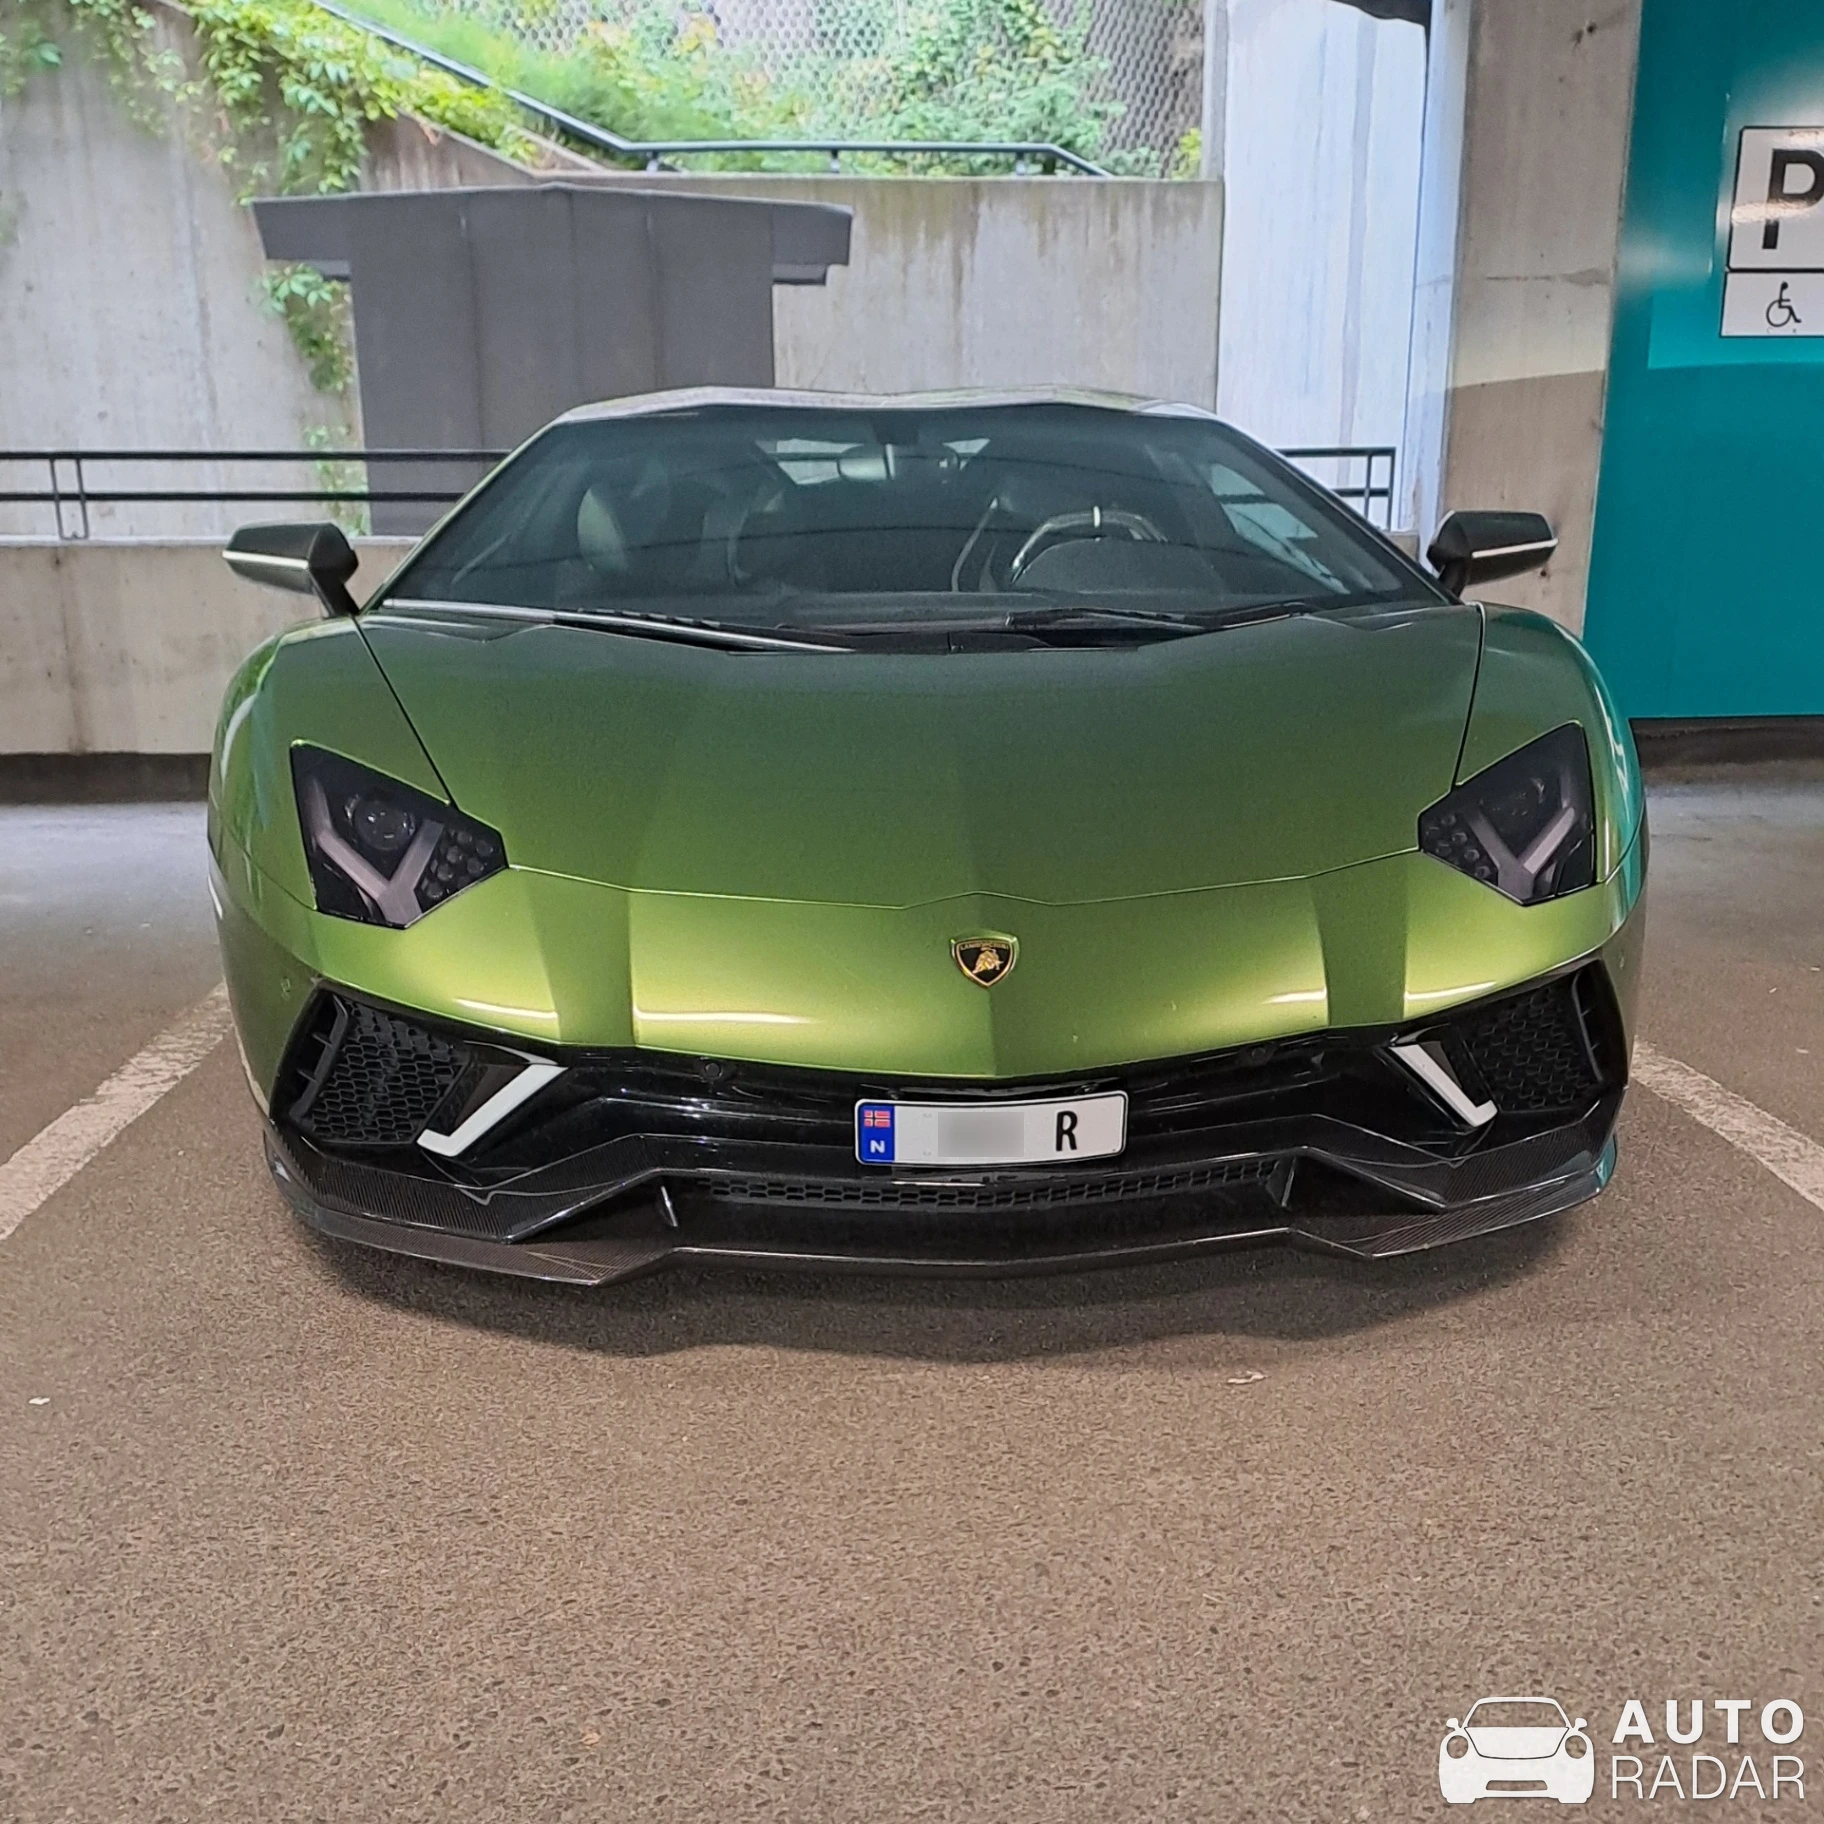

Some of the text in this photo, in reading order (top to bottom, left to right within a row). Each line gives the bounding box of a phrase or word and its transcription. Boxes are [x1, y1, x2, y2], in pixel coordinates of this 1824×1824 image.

[1762, 149, 1824, 249] P
[870, 1140, 885, 1153] N
[1055, 1110, 1078, 1151] R
